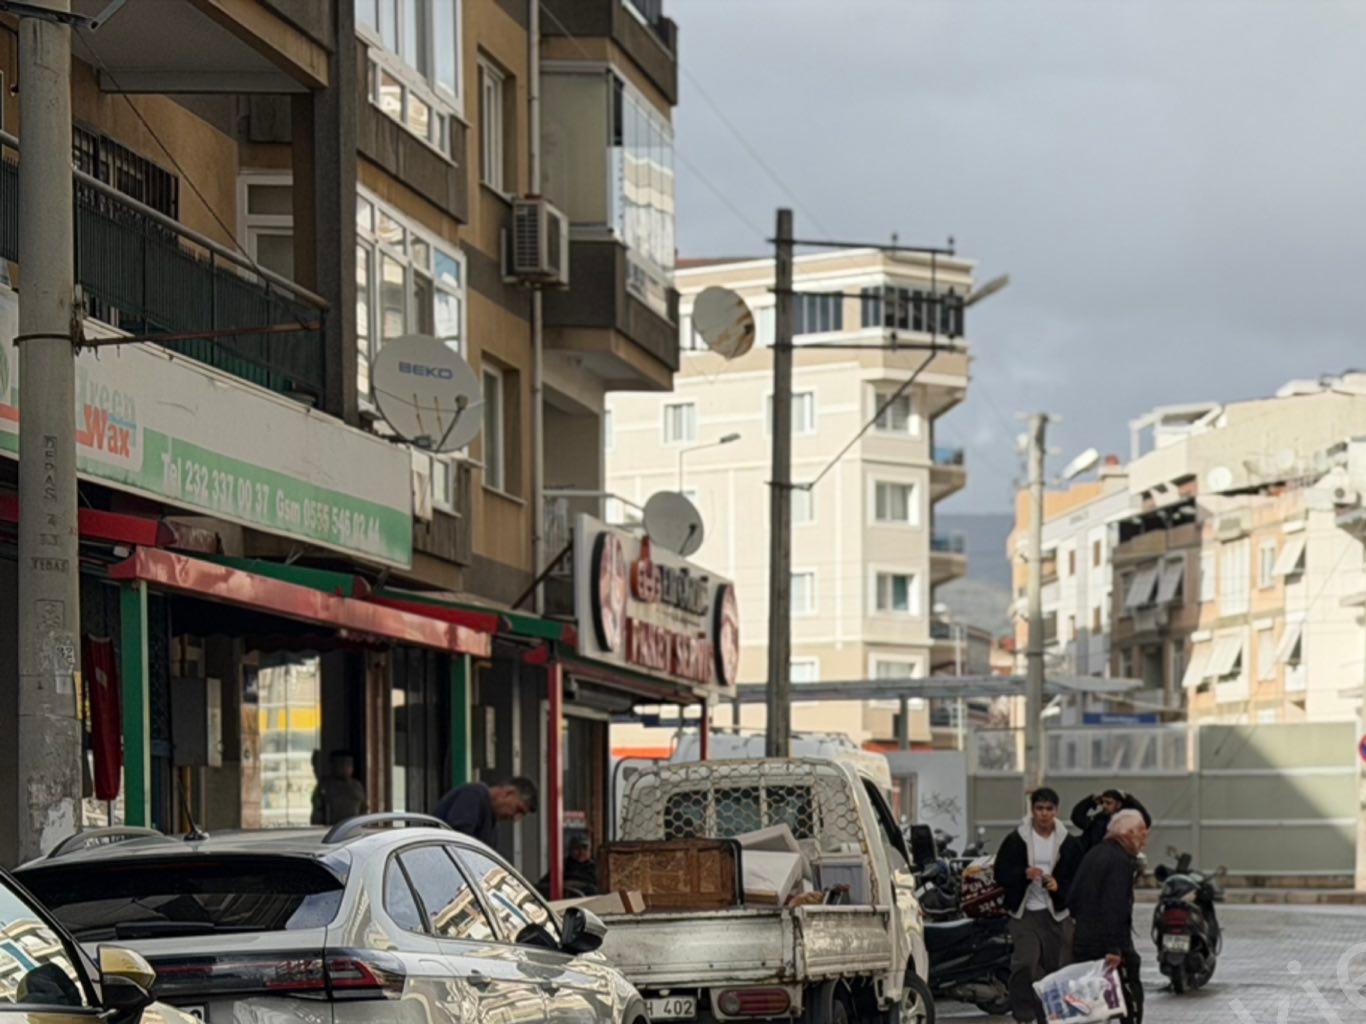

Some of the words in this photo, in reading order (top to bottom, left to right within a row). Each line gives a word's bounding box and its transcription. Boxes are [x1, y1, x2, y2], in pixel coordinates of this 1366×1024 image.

[398, 361, 453, 380] BEKO
[83, 403, 130, 459] Wax
[185, 460, 208, 499] 232
[663, 999, 693, 1016] 402
